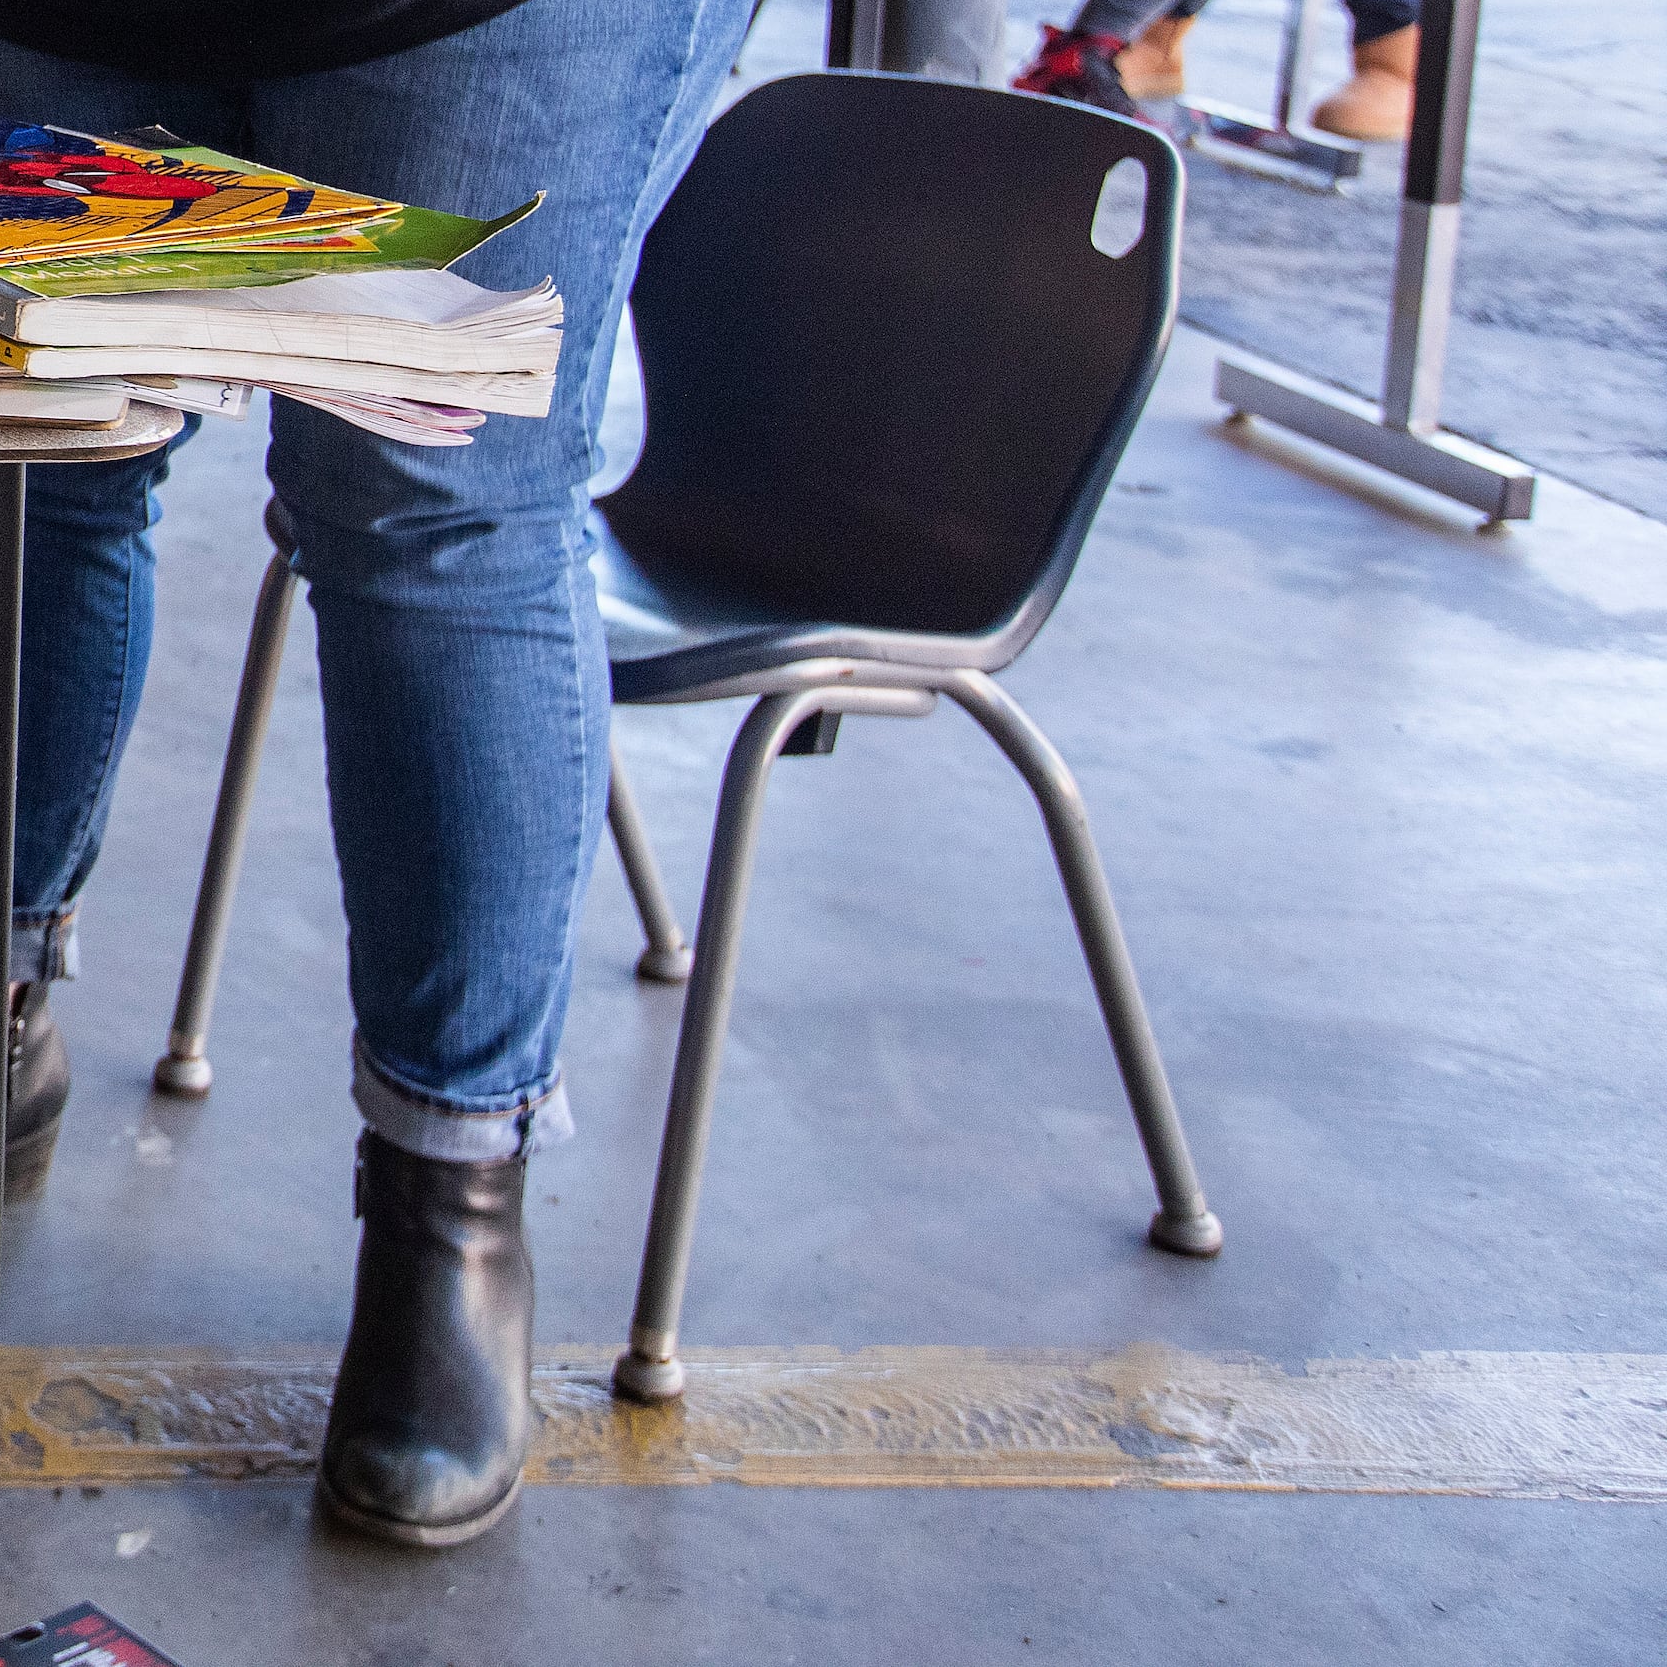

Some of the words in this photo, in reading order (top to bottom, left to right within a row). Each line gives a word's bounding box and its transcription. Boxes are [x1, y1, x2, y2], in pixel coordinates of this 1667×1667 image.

[8, 264, 174, 281] Module
[177, 262, 202, 272] 1
[4, 345, 13, 358] P
